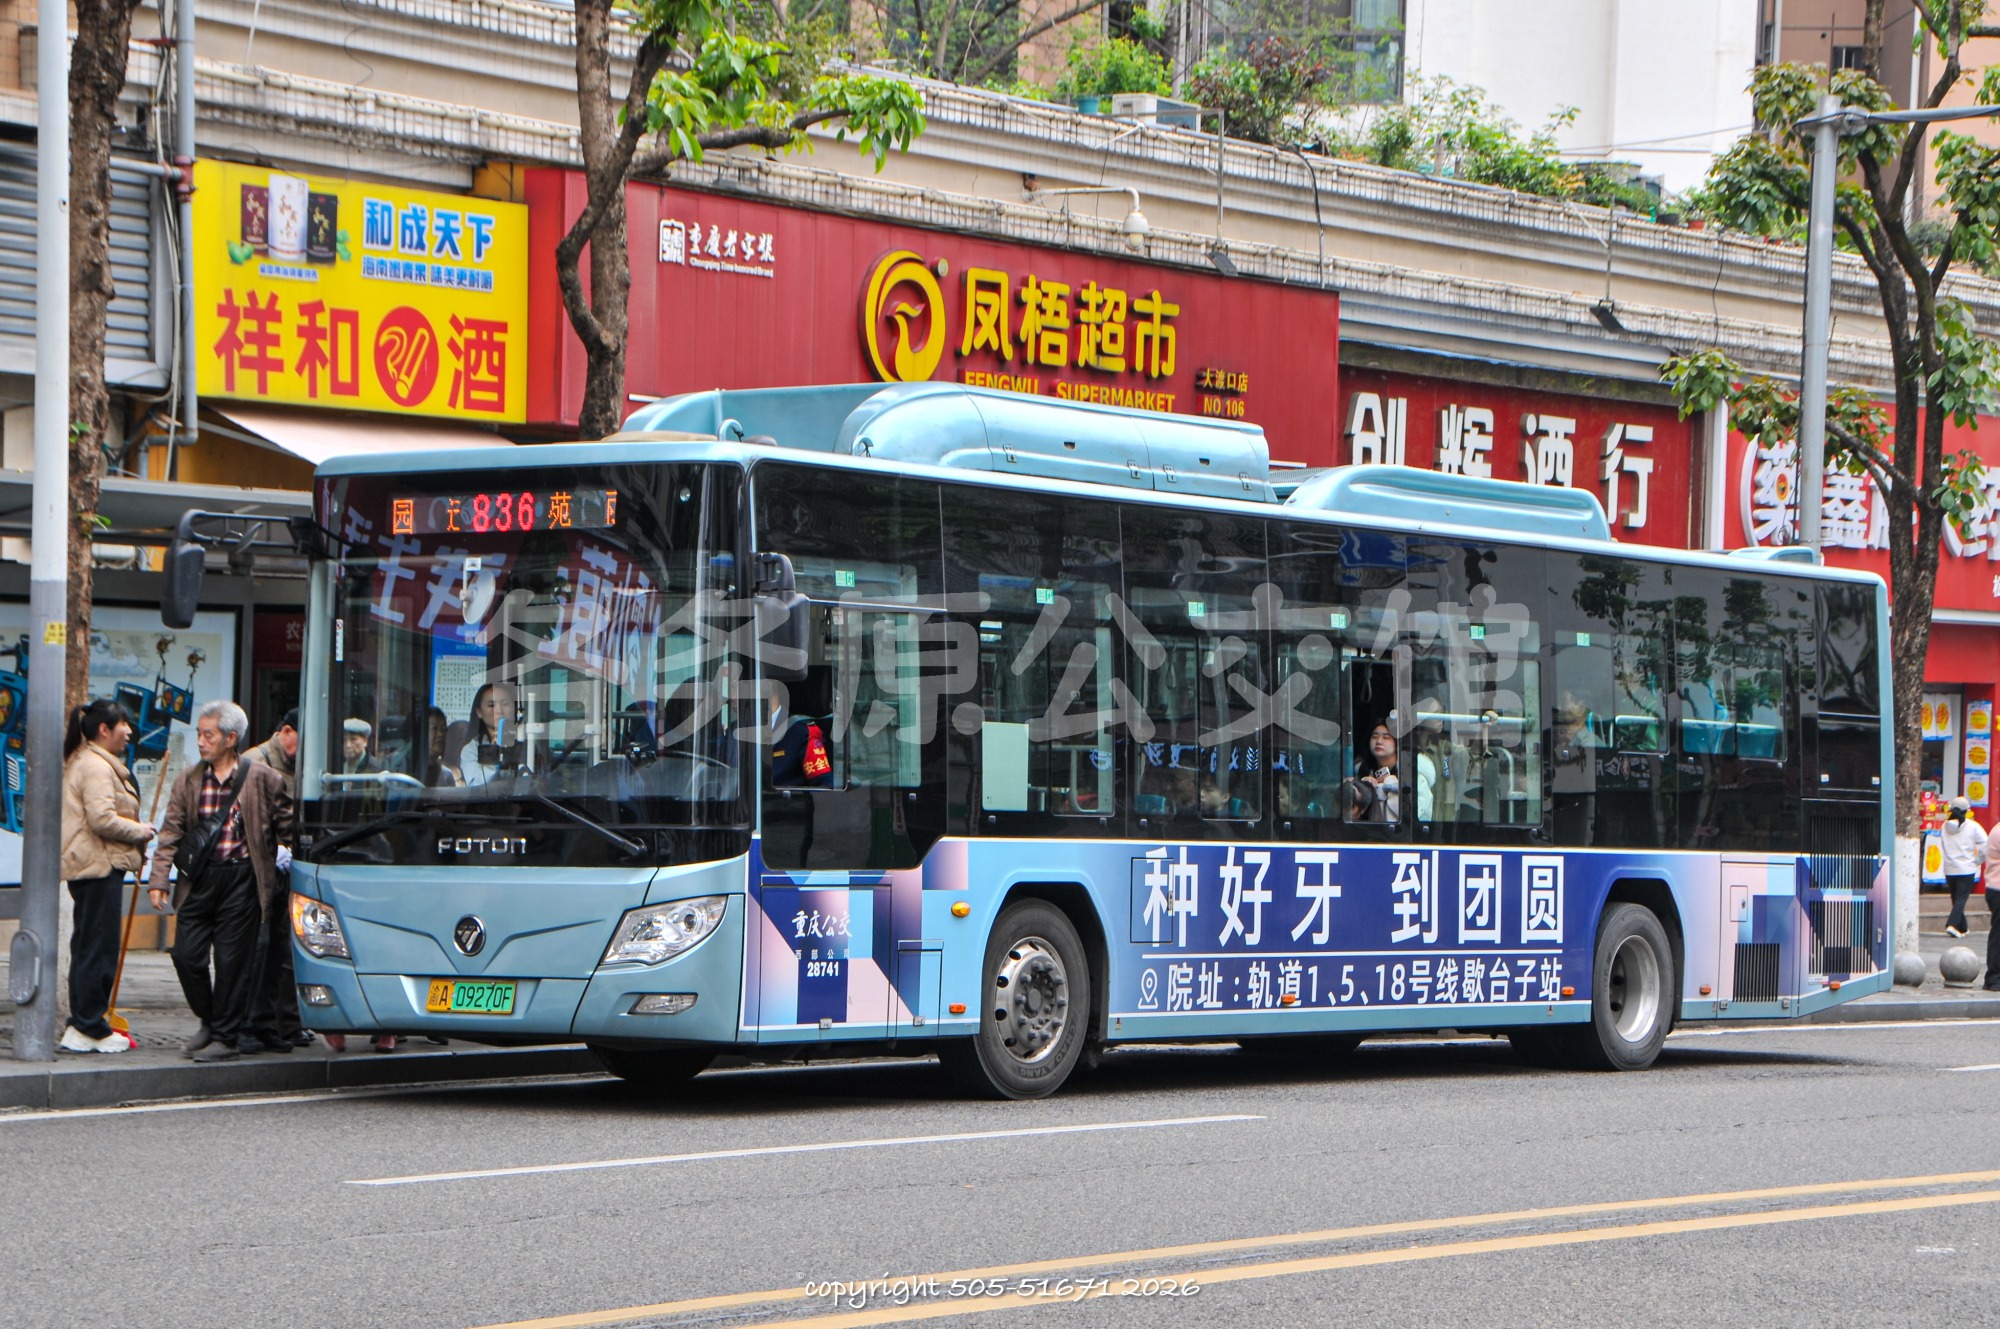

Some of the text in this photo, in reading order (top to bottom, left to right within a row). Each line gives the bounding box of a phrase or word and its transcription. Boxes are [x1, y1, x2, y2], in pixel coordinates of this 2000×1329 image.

[362, 196, 495, 263] 和成天下
[689, 256, 720, 272] Chongqing
[961, 267, 1180, 379] 凤梧超市
[213, 288, 508, 413] 祥和 酒
[965, 371, 1176, 412] FENGWU SUPERMARKET
[1203, 368, 1248, 393] 大渡口店
[1226, 399, 1245, 417] 106
[1347, 391, 1654, 528] 创辉酒行
[393, 500, 413, 534] 园
[473, 491, 535, 533] 836
[549, 490, 572, 530] 苑
[437, 837, 527, 855] FOTON
[1143, 846, 1564, 948] 种好牙 到团圆
[792, 910, 853, 939] 重庆公交
[795, 948, 849, 961] 西部公司
[807, 961, 839, 978] 28741
[455, 985, 513, 1009] 09270F
